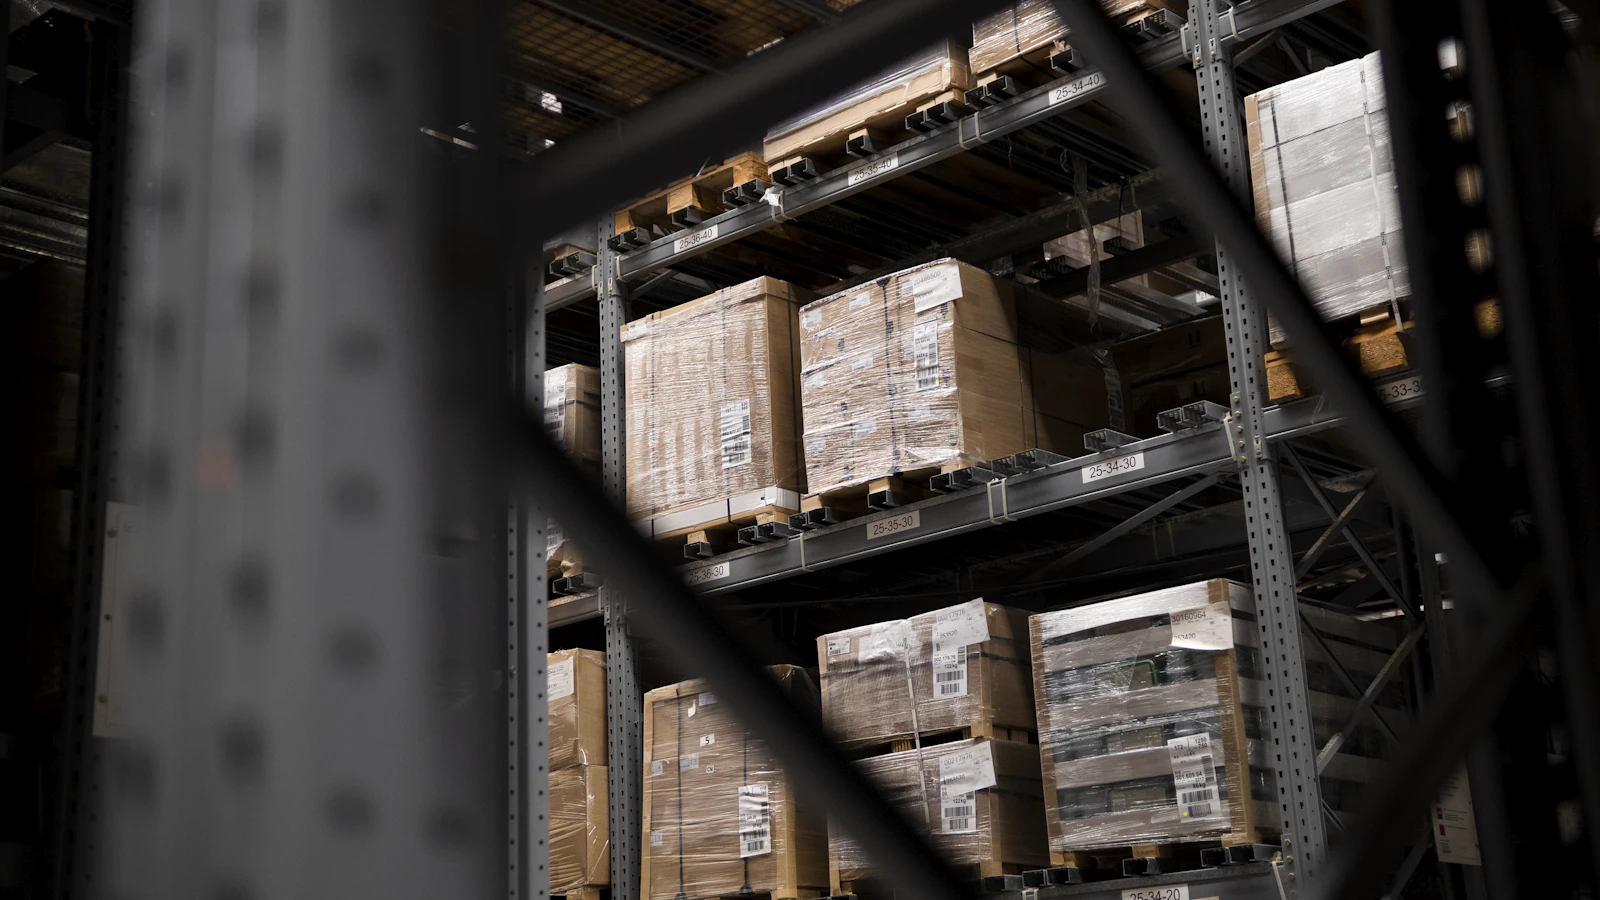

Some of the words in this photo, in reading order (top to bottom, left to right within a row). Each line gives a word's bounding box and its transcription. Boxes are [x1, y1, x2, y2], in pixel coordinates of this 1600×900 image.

[1056, 74, 1100, 100] 25-34-40
[854, 157, 892, 181] 25-35-40
[679, 228, 713, 250] 25-36-40
[1379, 380, 1424, 401] 5-33-3
[1089, 456, 1137, 479] 25-34-30
[873, 515, 913, 535] 25-35-30
[689, 565, 724, 584] 25-36-30
[1171, 610, 1207, 623] 30160964
[1173, 632, 1197, 642] 253420
[705, 736, 710, 744] 5
